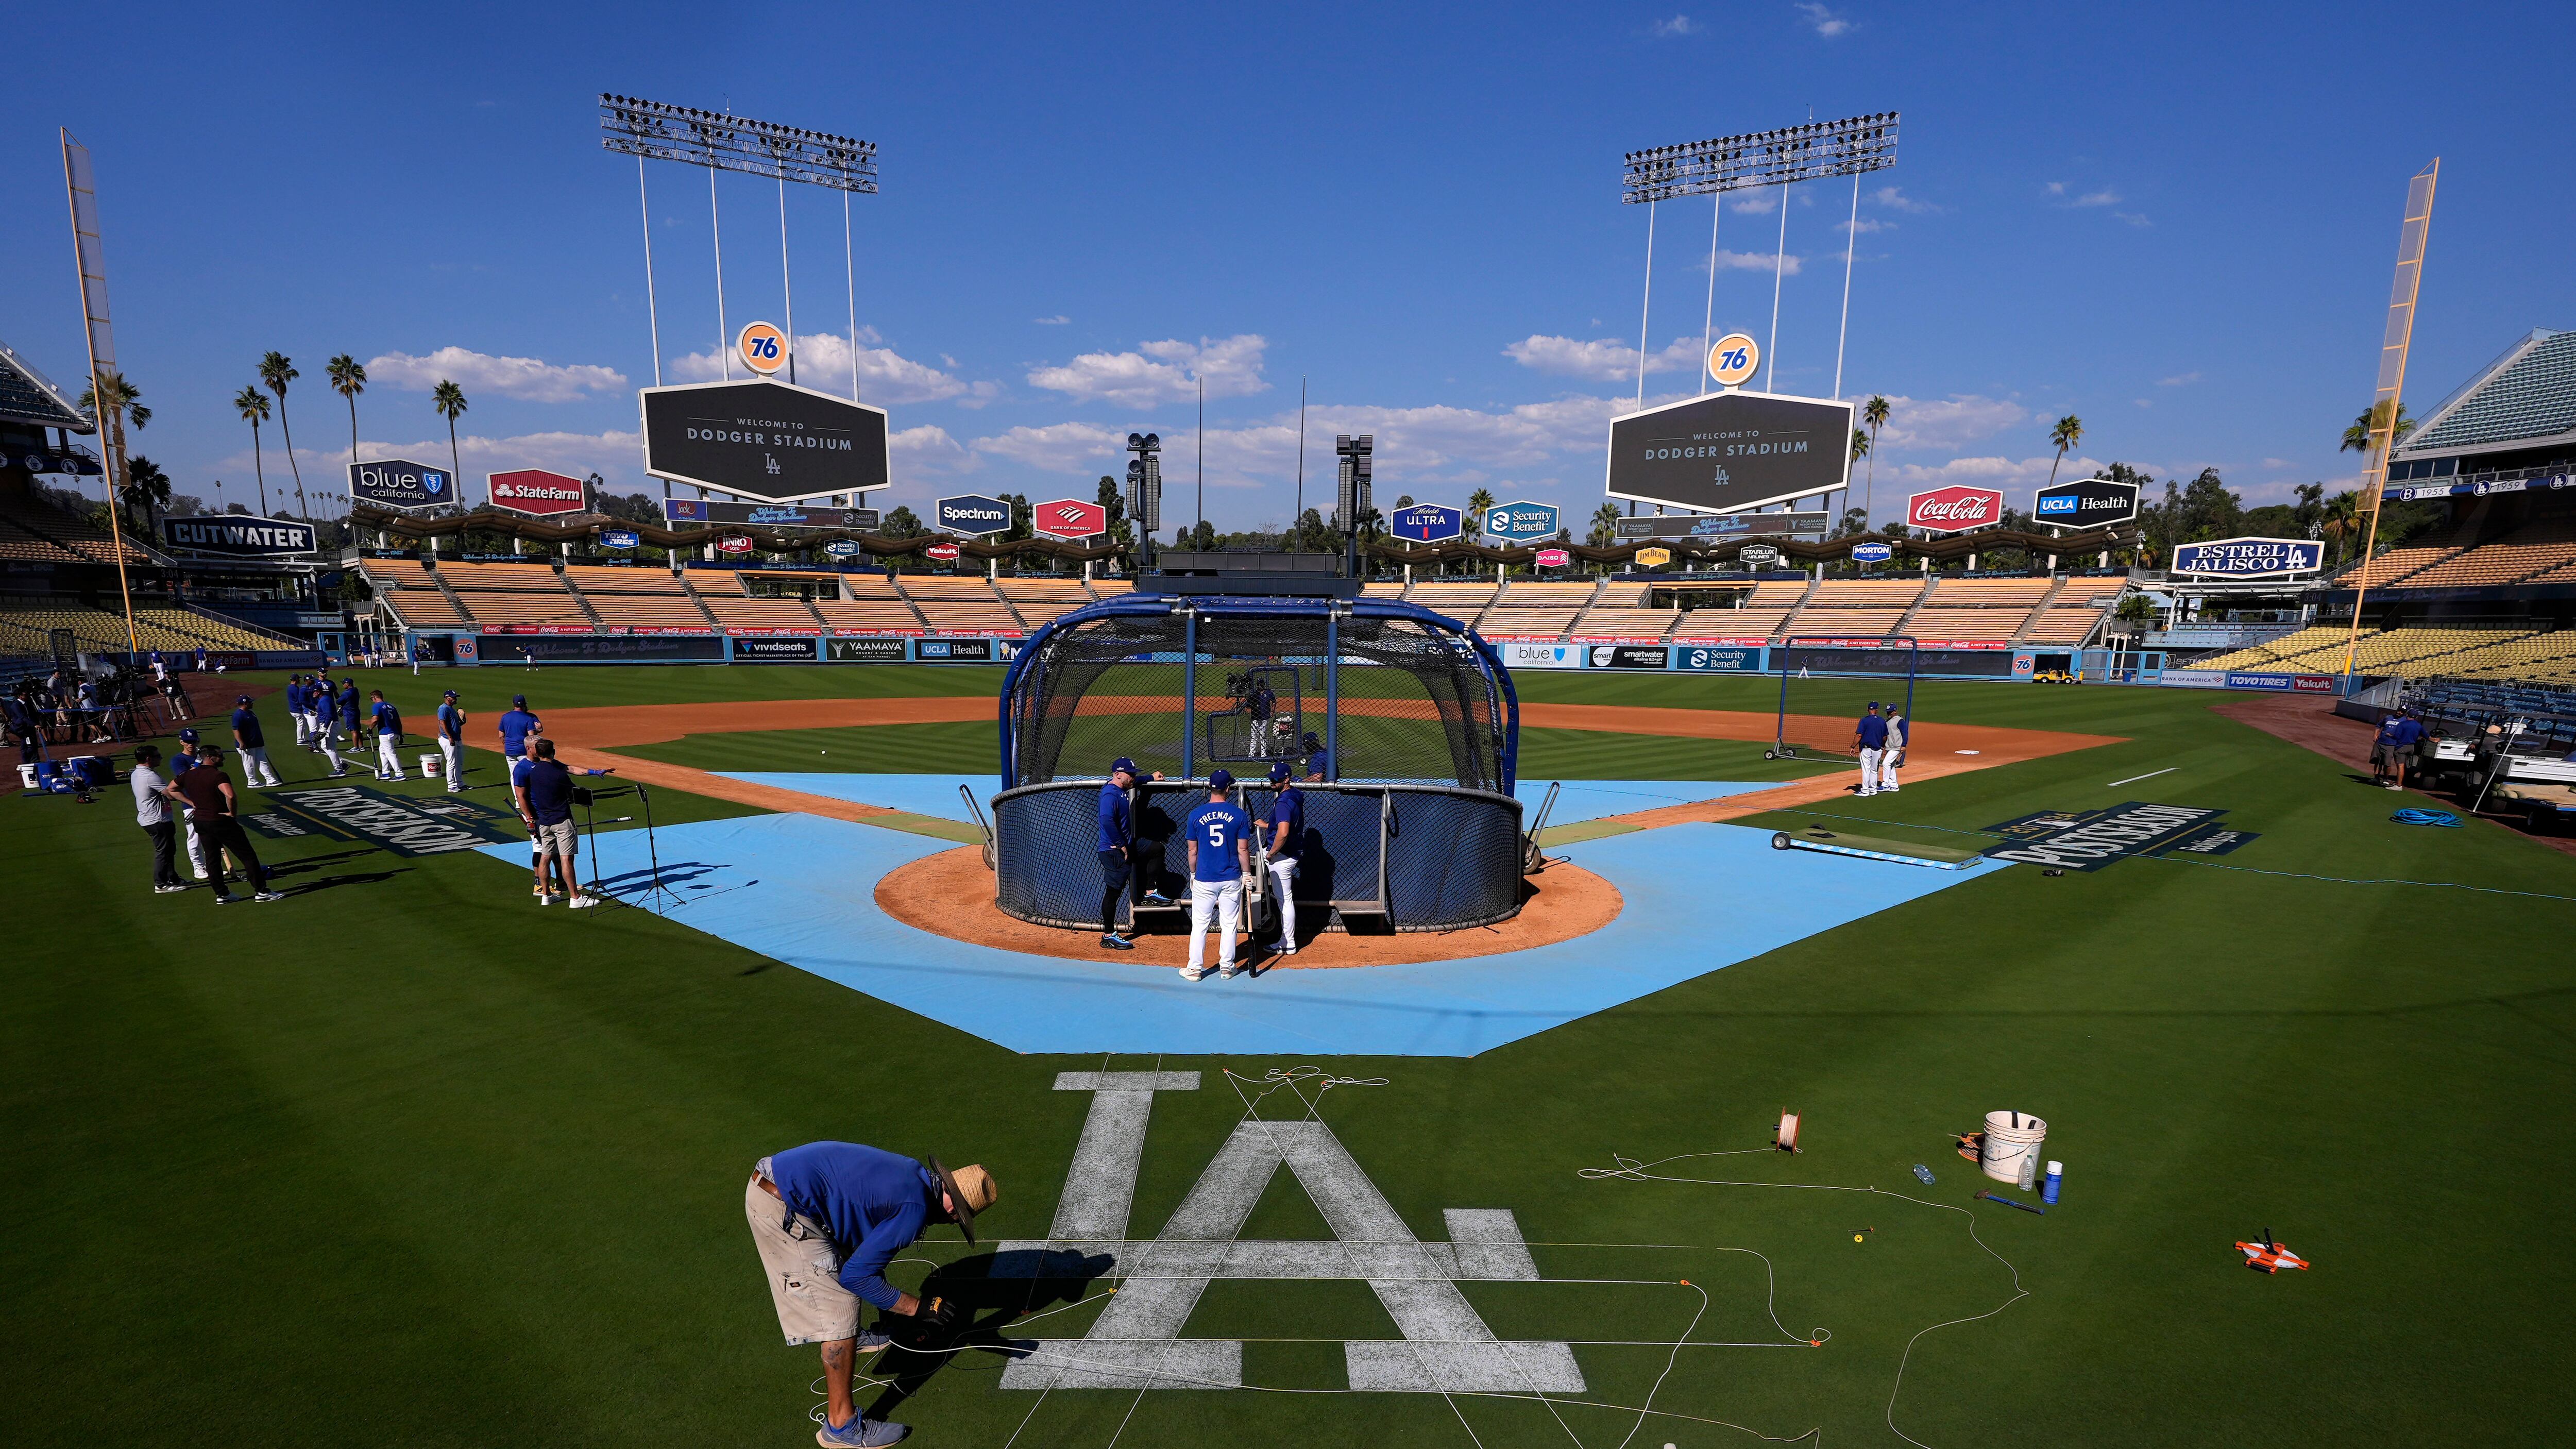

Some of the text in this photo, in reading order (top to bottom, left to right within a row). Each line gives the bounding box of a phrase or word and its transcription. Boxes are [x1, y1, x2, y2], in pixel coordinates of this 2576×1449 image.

[750, 335, 779, 360] 76
[1719, 346, 1749, 371] 76
[737, 417, 787, 429] WELCOME
[687, 428, 852, 451] DODGER STADIUM
[1693, 431, 1742, 441] WELCOME
[1646, 441, 1808, 460] DODGER STADIUM
[765, 453, 780, 475] LA
[360, 466, 417, 490] blue
[1715, 465, 1730, 485] LA
[2421, 488, 2444, 496] 1955
[2496, 481, 2520, 491] 1959
[371, 488, 425, 500] california
[516, 484, 580, 501] StateFarm
[677, 502, 696, 514] Jack
[1916, 496, 1993, 521] Coca-Cola
[2042, 496, 2127, 511] UCLA Health
[748, 512, 808, 523] Dodger Stadium
[756, 507, 787, 516] Welcome
[944, 506, 1002, 521] Spectrum
[1513, 511, 1552, 521] Security
[1406, 516, 1446, 525] ULTRA
[1513, 521, 1546, 532] Benefit
[1700, 518, 1730, 527] Welcome
[1690, 523, 1750, 534] Dodger Stadium
[175, 524, 305, 548] CUTWATER
[722, 537, 747, 548] JINRO
[1638, 549, 1667, 562] JIM BEAM
[2196, 544, 2307, 569] ESTREL LA
[2185, 558, 2279, 571] JALISCO
[161, 569, 179, 578] 3:04
[2304, 593, 2321, 602] 3:04
[457, 642, 474, 654] 76
[754, 642, 806, 651] vividseats
[953, 645, 985, 654] Health
[1519, 647, 1550, 659] blue
[1710, 650, 1746, 661] Security
[1710, 659, 1740, 668] Benefit
[2014, 659, 2031, 670] 76
[2230, 676, 2287, 686] TOYO TIRES
[2295, 679, 2331, 688] Yakult
[278, 787, 497, 853] POSTSEASON
[1199, 811, 1234, 825] FREEMAN
[1209, 824, 1224, 847] 5
[1990, 804, 2214, 868] POSTSEASON
[988, 1071, 1587, 1393] LA
